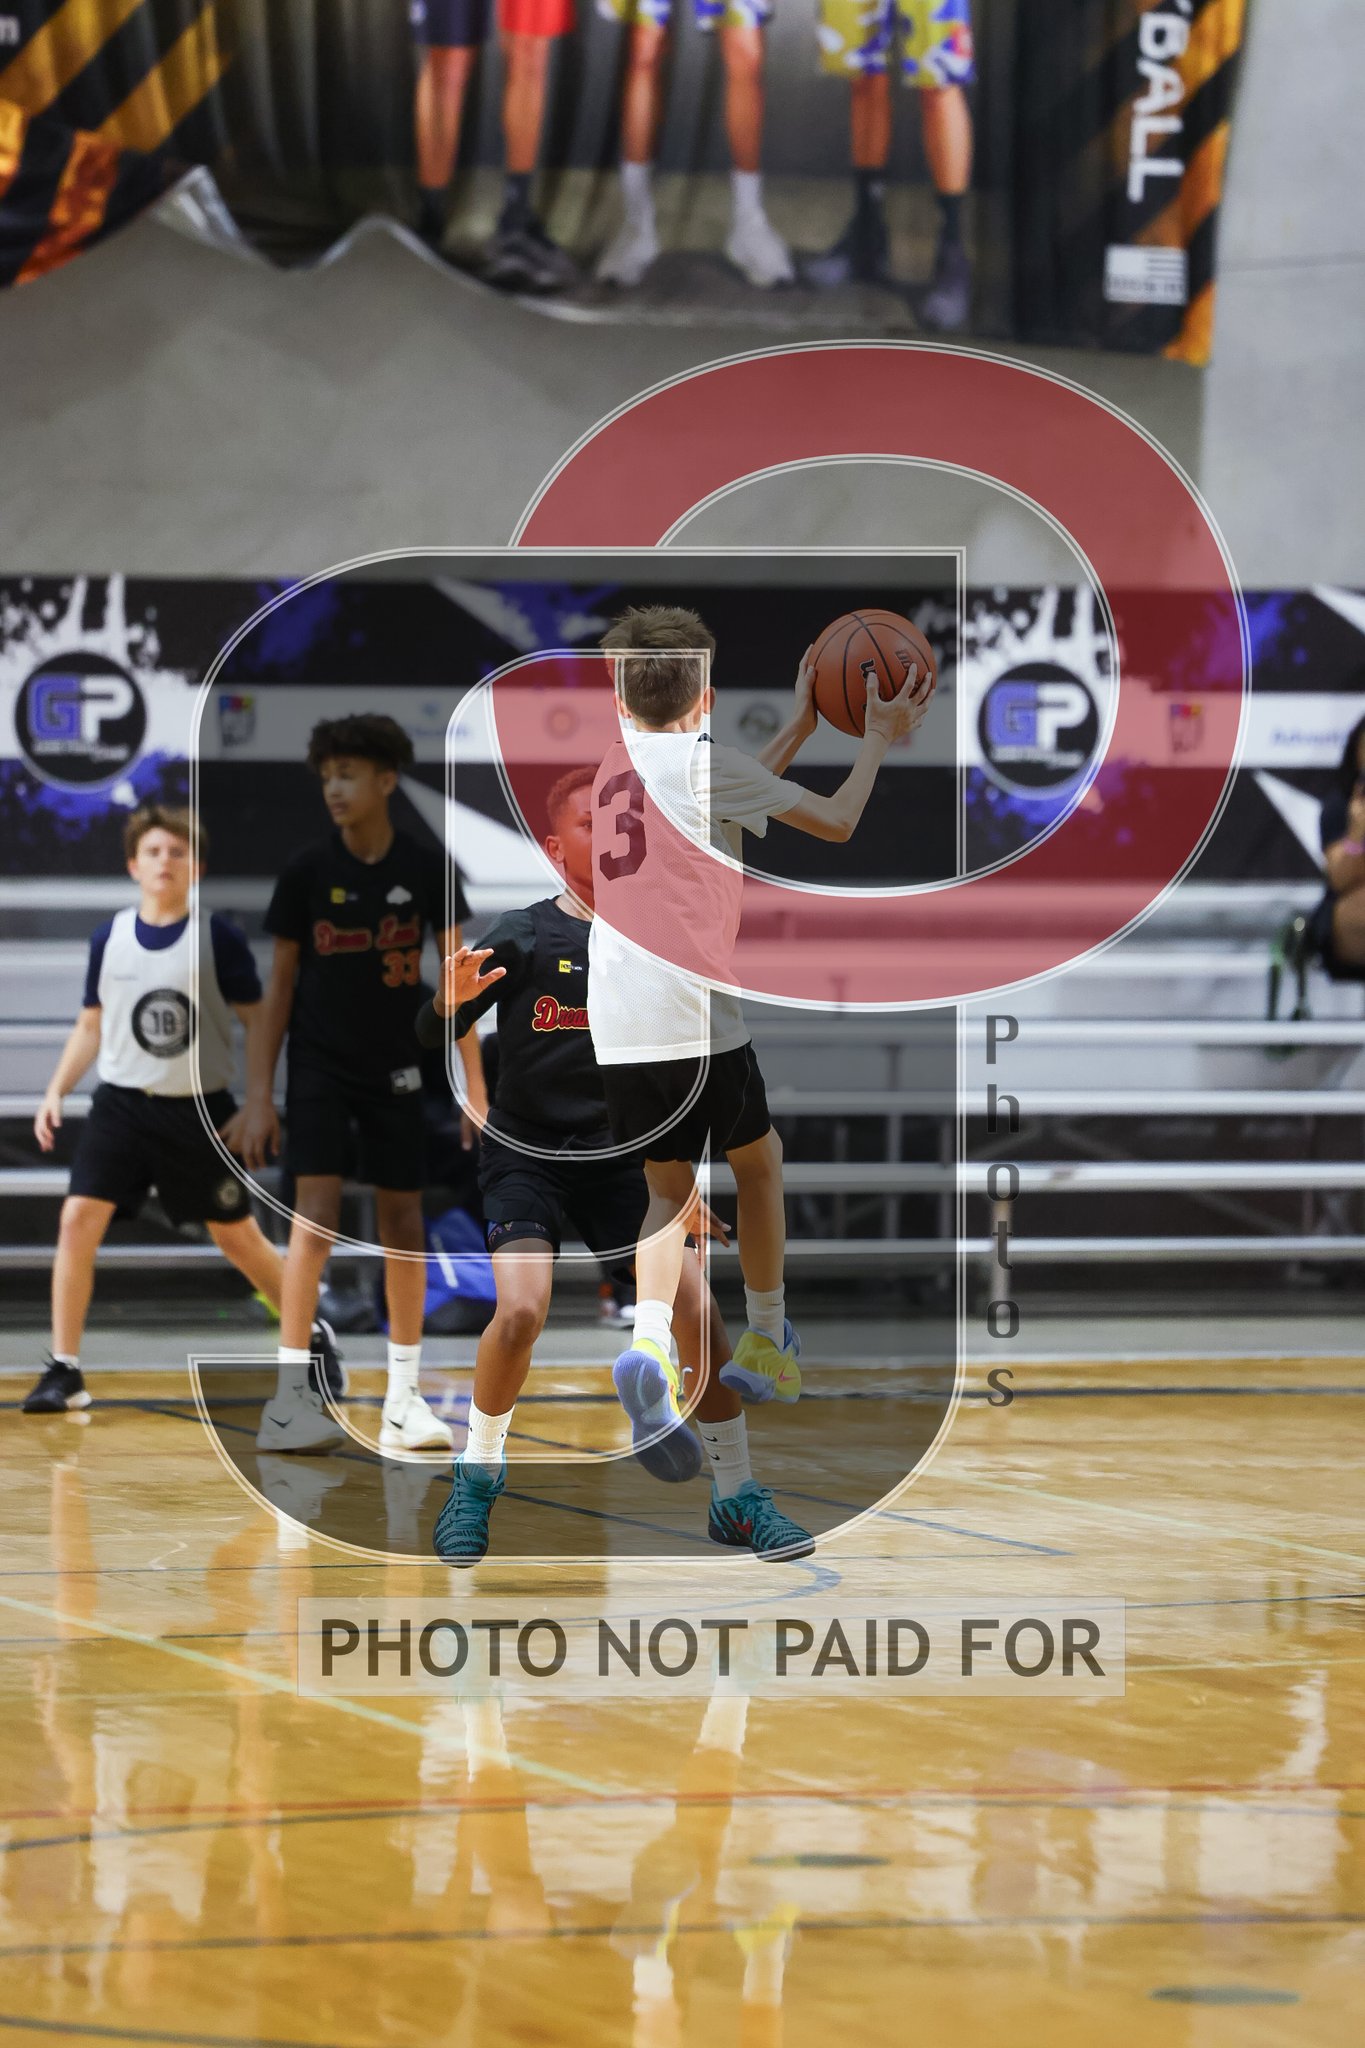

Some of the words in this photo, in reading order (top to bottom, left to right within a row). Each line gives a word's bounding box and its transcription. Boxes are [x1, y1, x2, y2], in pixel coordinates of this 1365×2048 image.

[1127, 0, 1190, 201] BALL
[27, 672, 134, 744] GP
[985, 681, 1090, 750] GP
[599, 769, 646, 881] 3
